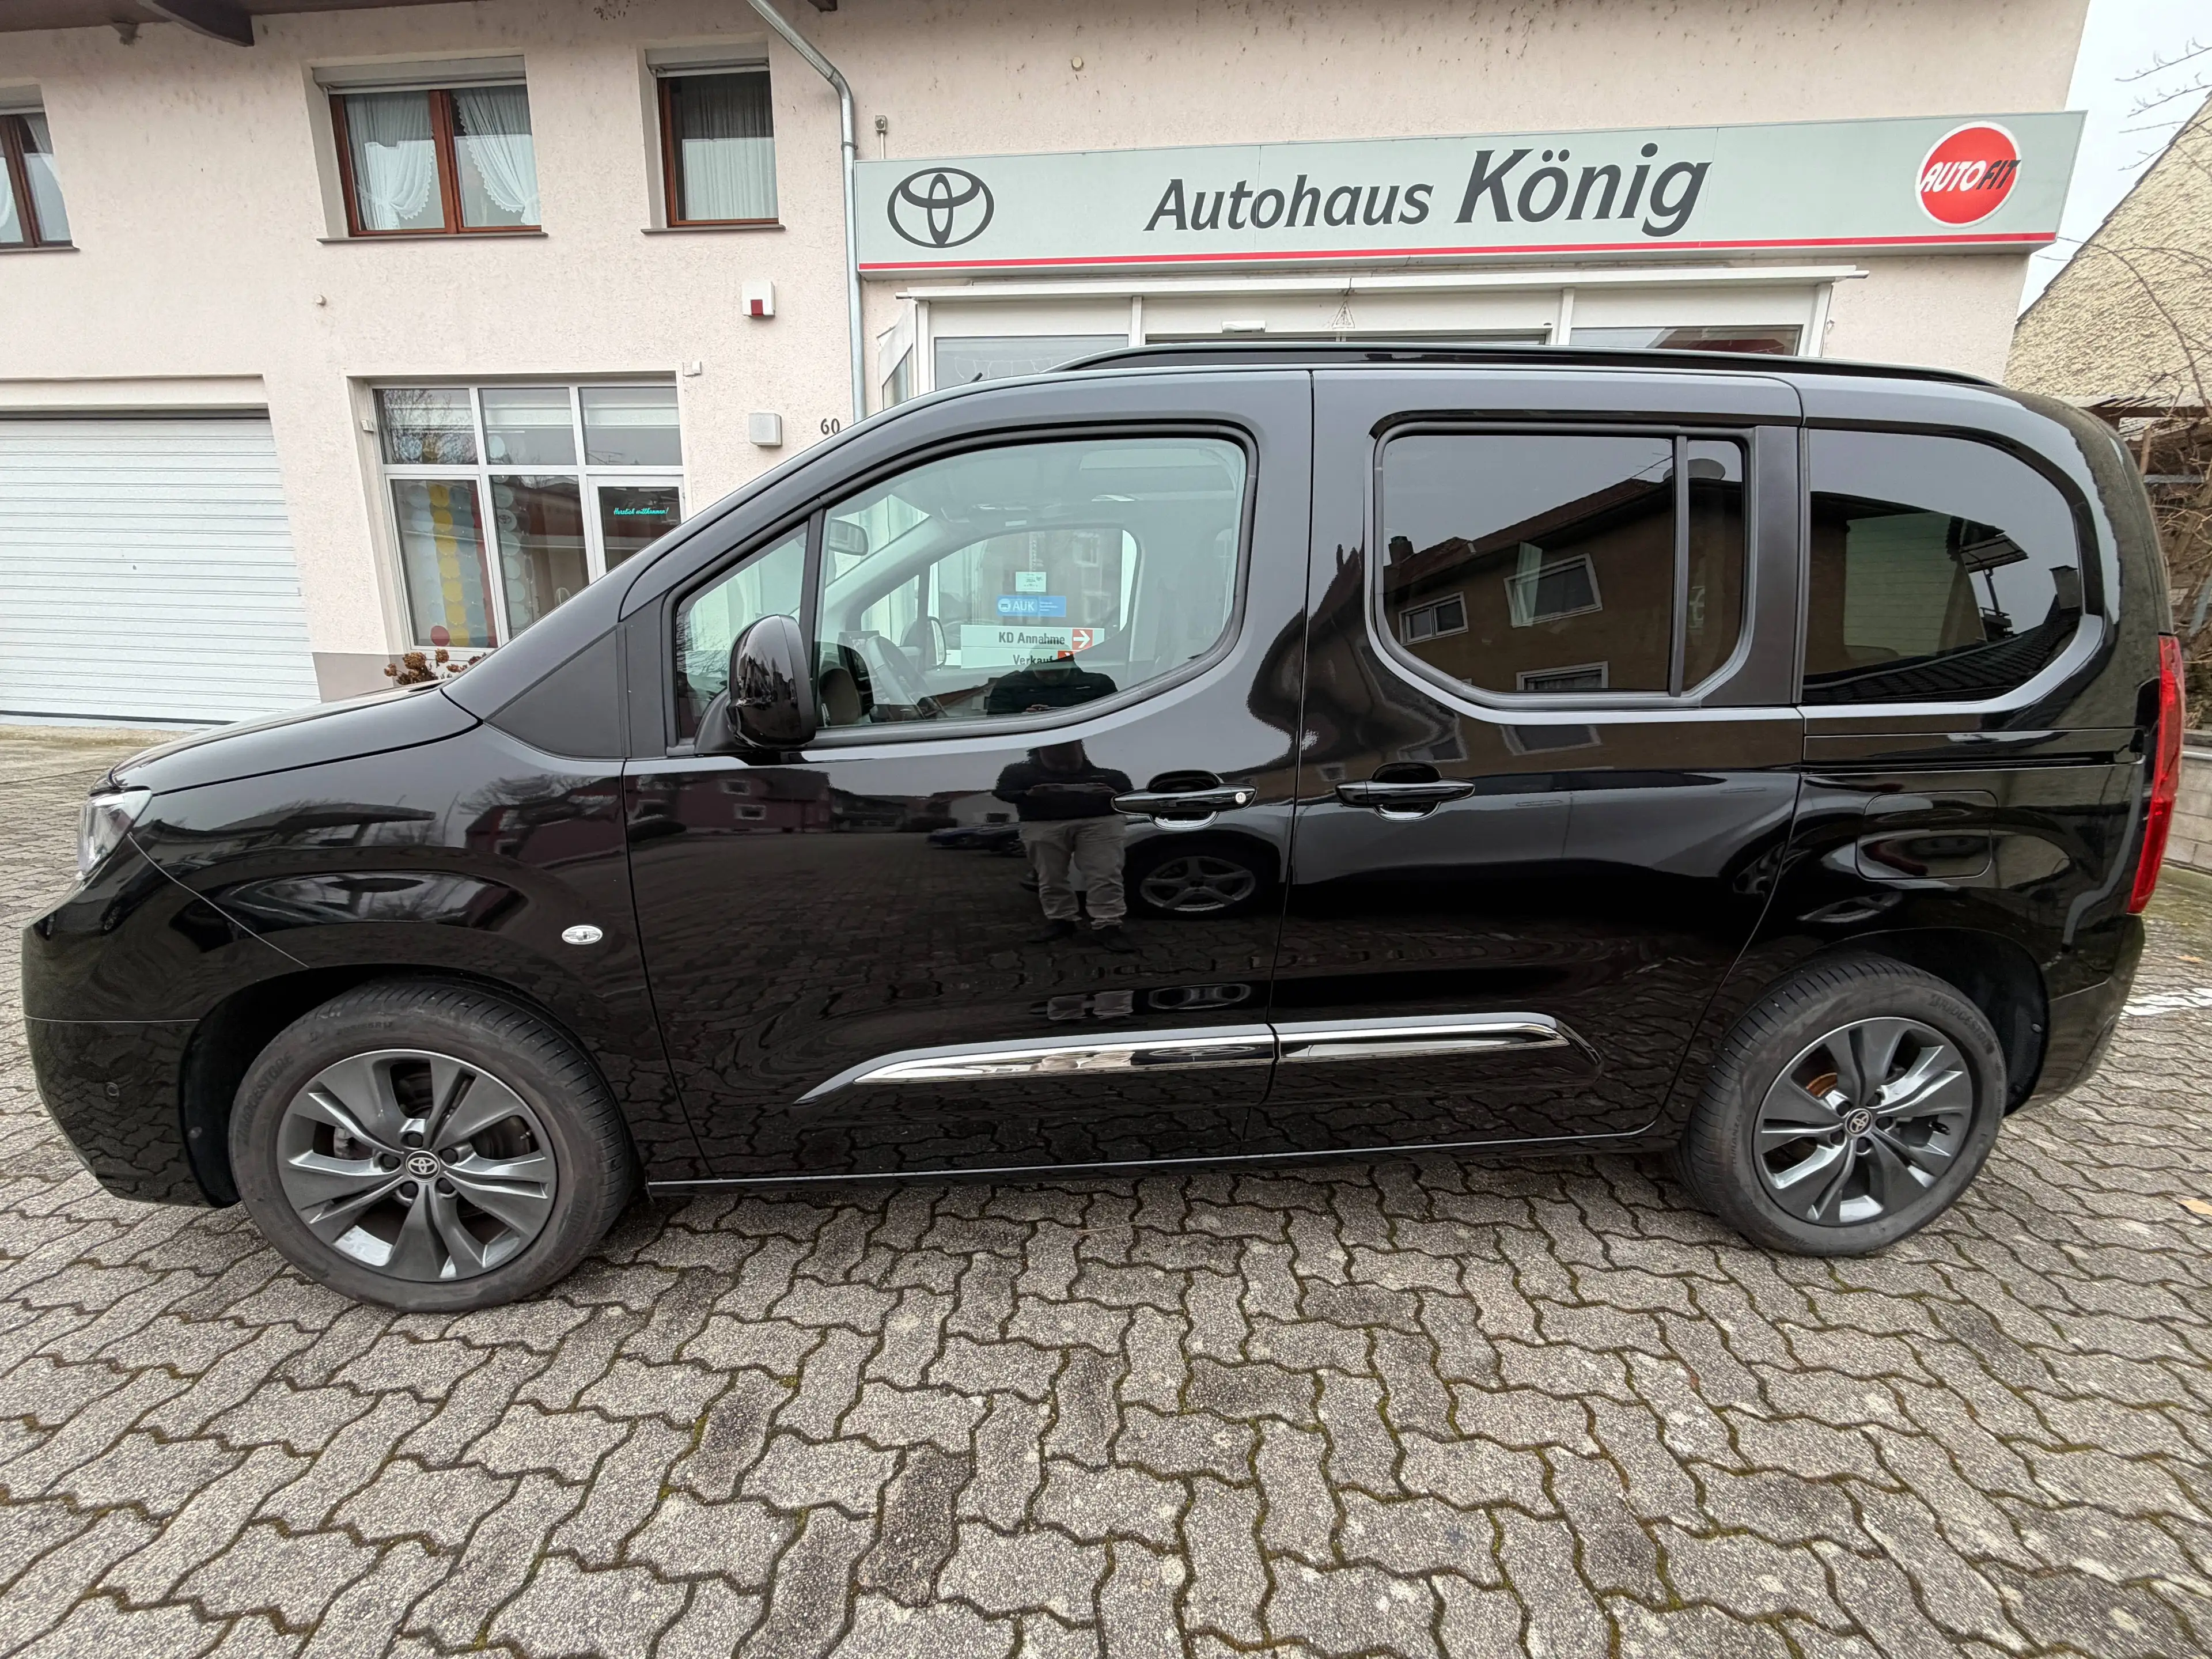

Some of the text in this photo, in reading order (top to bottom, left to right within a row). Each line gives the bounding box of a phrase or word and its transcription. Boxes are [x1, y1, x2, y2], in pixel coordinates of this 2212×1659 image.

[1144, 142, 1711, 237] Autohaus König
[820, 418, 840, 435] 60
[1013, 601, 1035, 611] AUK
[999, 631, 1065, 645] KD Annahme
